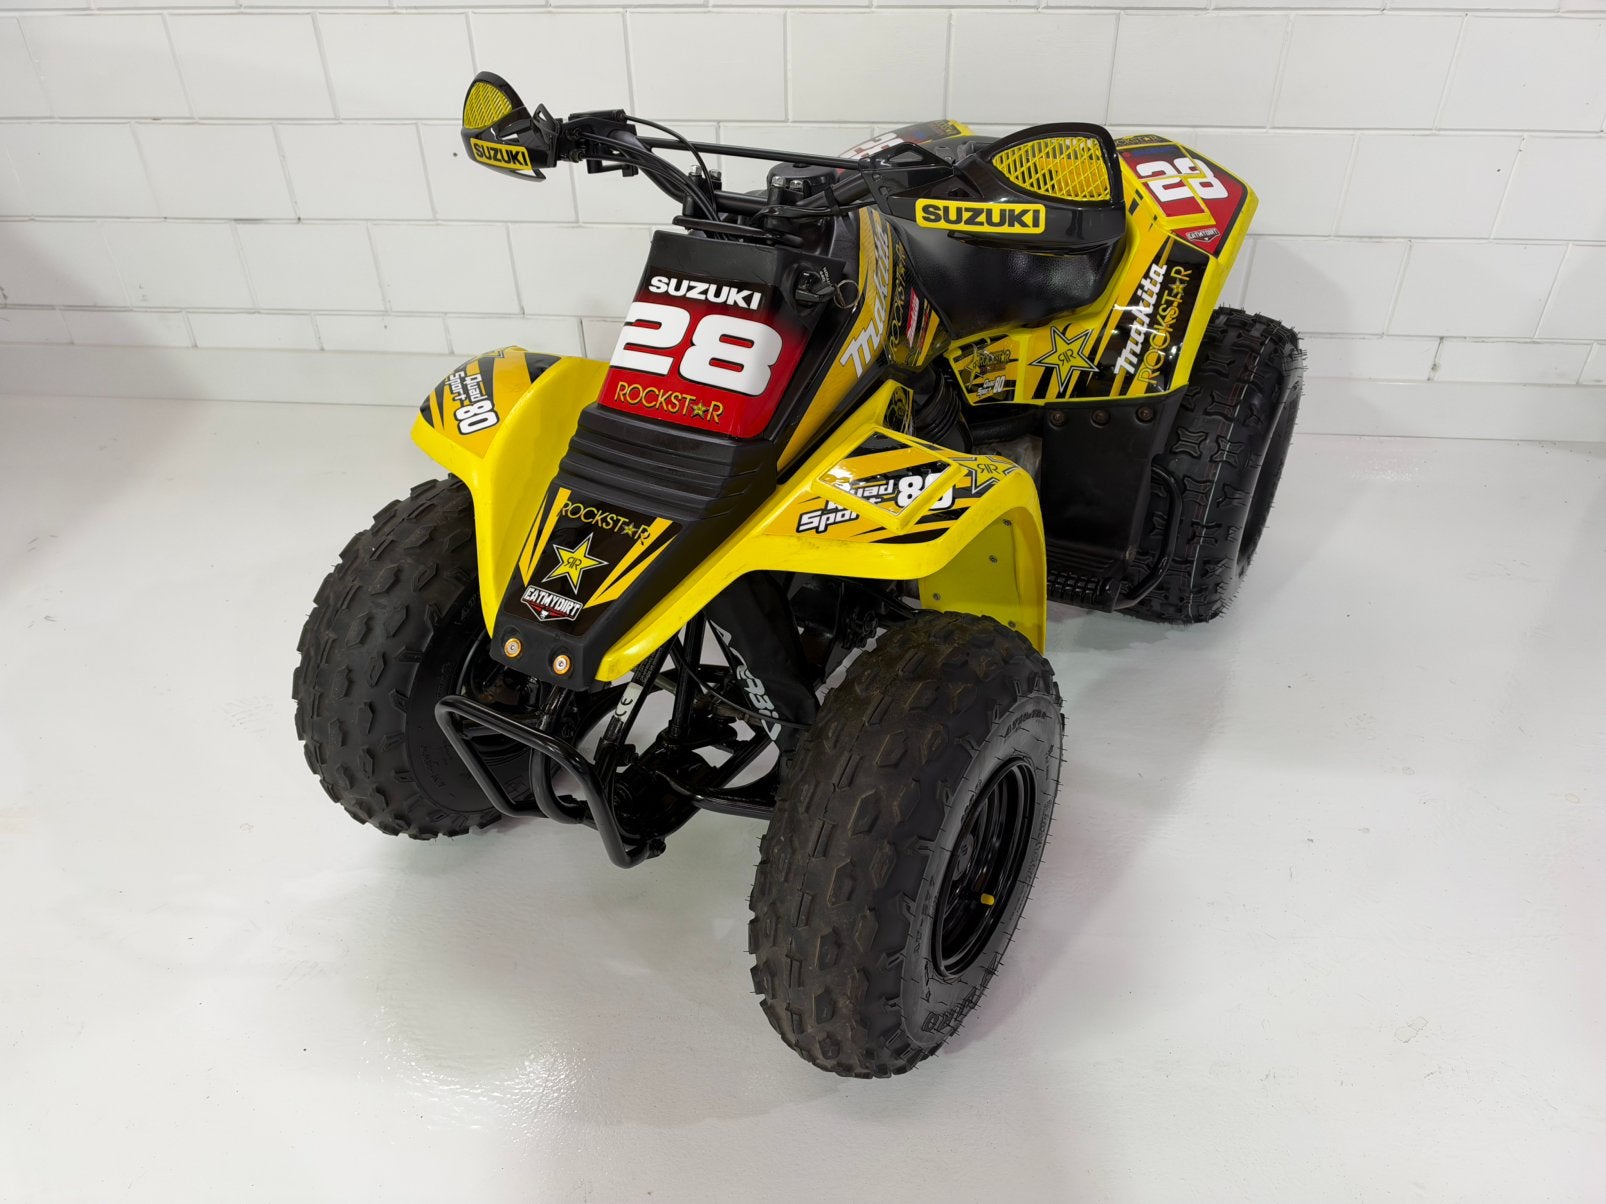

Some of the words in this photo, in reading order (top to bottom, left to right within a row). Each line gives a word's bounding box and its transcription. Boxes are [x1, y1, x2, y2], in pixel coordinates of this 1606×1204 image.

[473, 143, 529, 166] SUZUKI
[1136, 157, 1229, 202] 28
[921, 204, 1041, 228] SUZUKI
[649, 276, 762, 311] SUZUKI
[609, 301, 783, 397] 28
[445, 371, 467, 401] Sport
[464, 373, 488, 402] Quad
[455, 399, 499, 435] 80
[523, 588, 581, 616] EATMYDIRT
